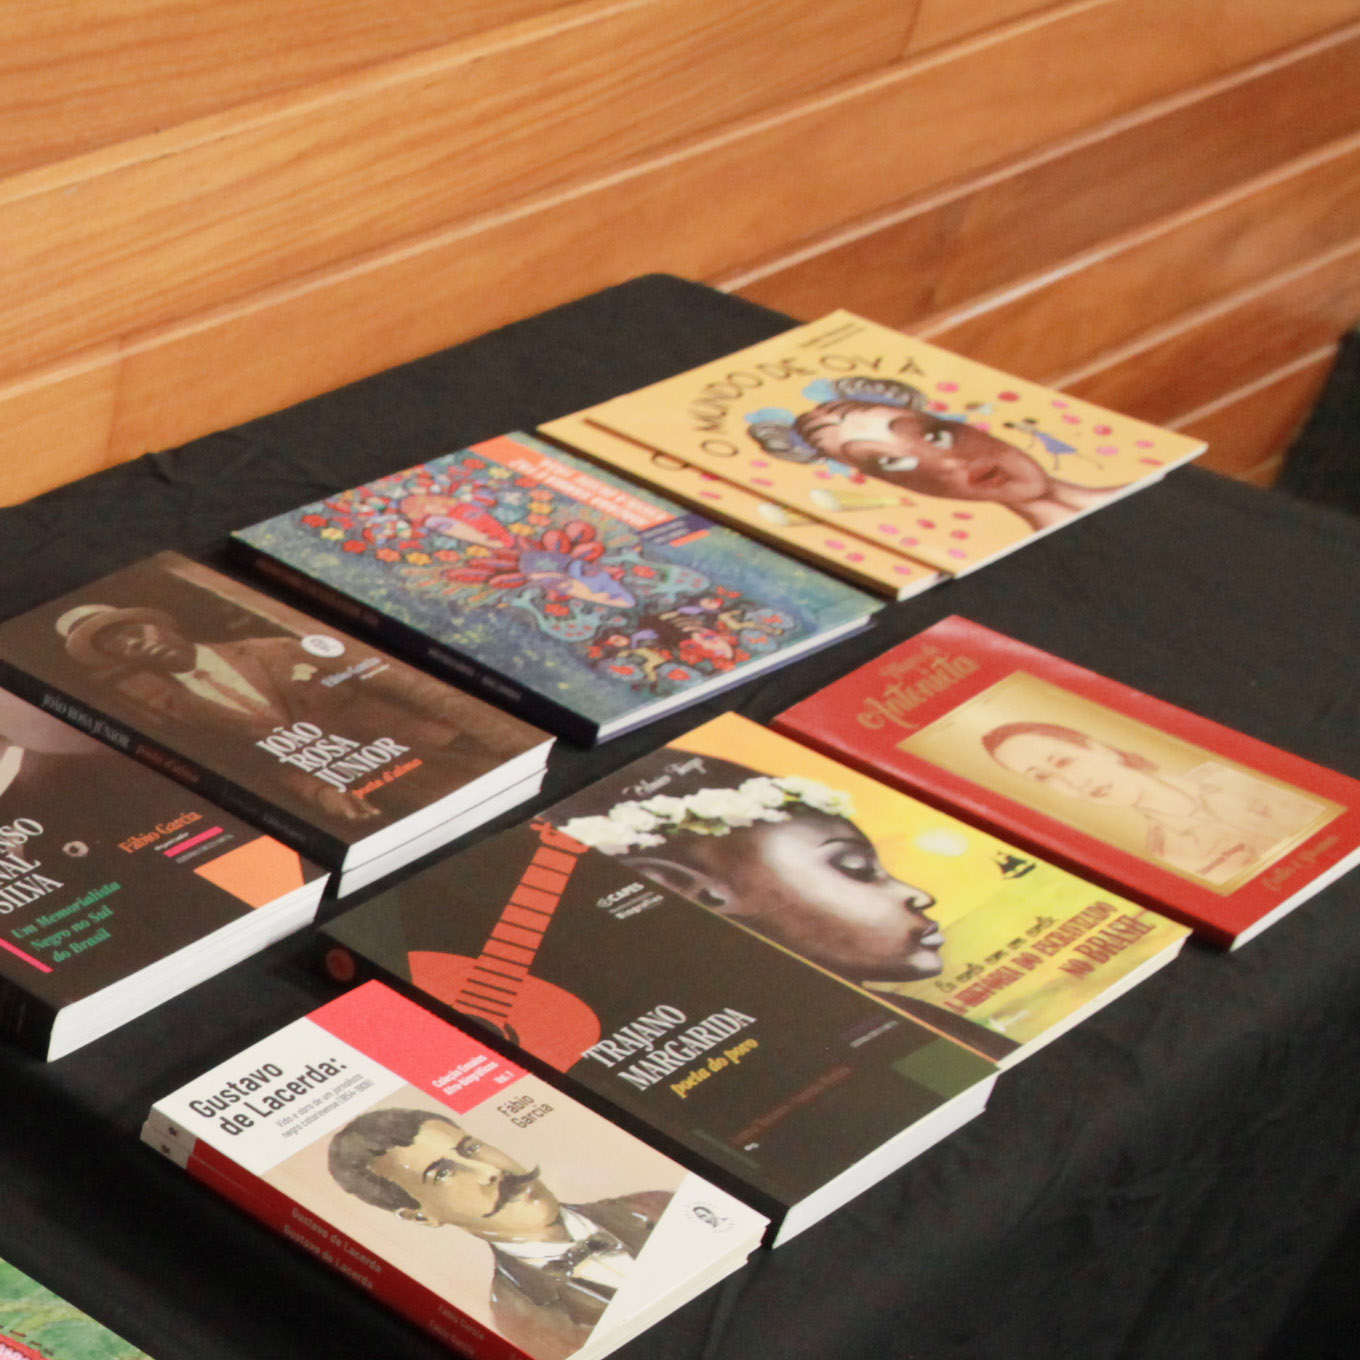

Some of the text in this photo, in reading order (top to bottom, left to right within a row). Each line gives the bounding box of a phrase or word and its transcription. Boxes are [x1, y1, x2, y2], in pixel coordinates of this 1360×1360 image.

[256, 722, 322, 763] JOÃO
[285, 735, 361, 772] ROSA
[118, 829, 161, 854] Fábio
[155, 811, 203, 837] Garcia
[69, 927, 112, 955] Brasil
[581, 1004, 687, 1069] TRAJANO
[617, 1007, 757, 1091] MARGARIDA
[707, 1056, 729, 1074] do
[189, 1060, 284, 1120] Gustavo
[218, 1056, 348, 1137] de Lacerda:
[497, 1095, 534, 1117] Fábio
[511, 1103, 554, 1128] Garcia
[283, 1224, 321, 1254] Gustavo
[335, 1258, 374, 1290] Lacerda
[291, 1208, 382, 1273] Gustavo de Lacerda
